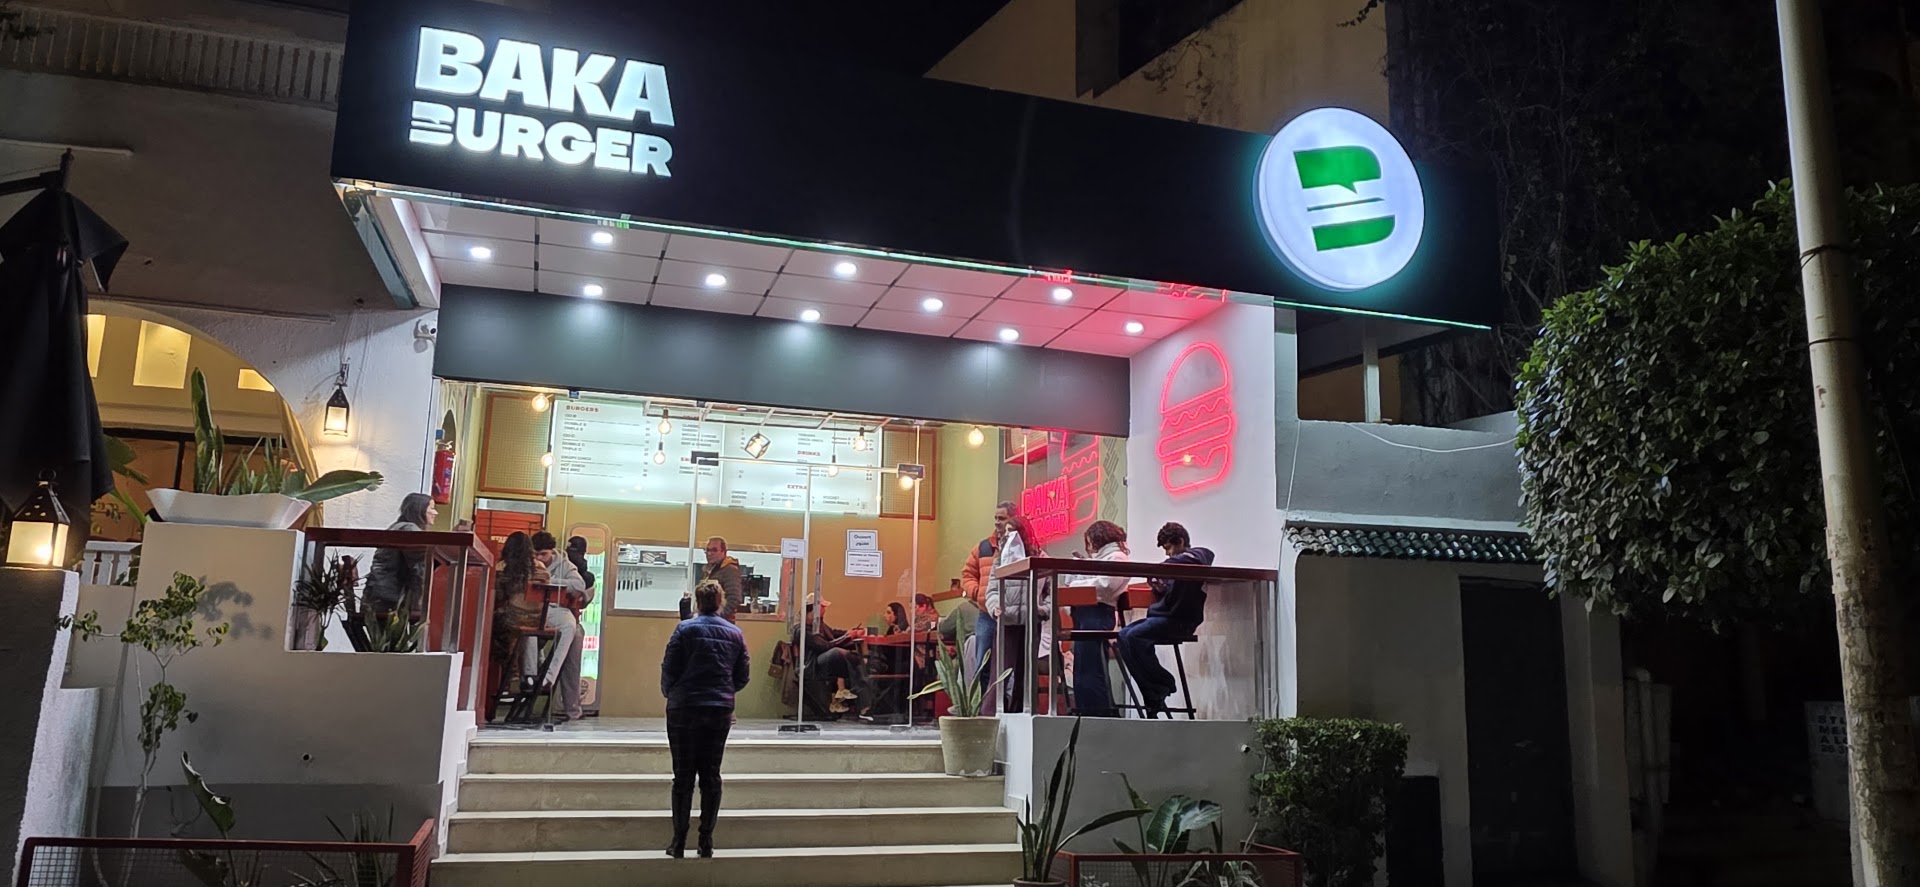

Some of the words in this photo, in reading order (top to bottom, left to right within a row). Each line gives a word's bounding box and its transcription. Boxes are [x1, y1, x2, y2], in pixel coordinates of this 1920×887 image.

[415, 26, 675, 126] BAKA
[409, 101, 673, 177] BURGER
[565, 405, 599, 413] BURGERS
[1021, 474, 1070, 519] BAKA
